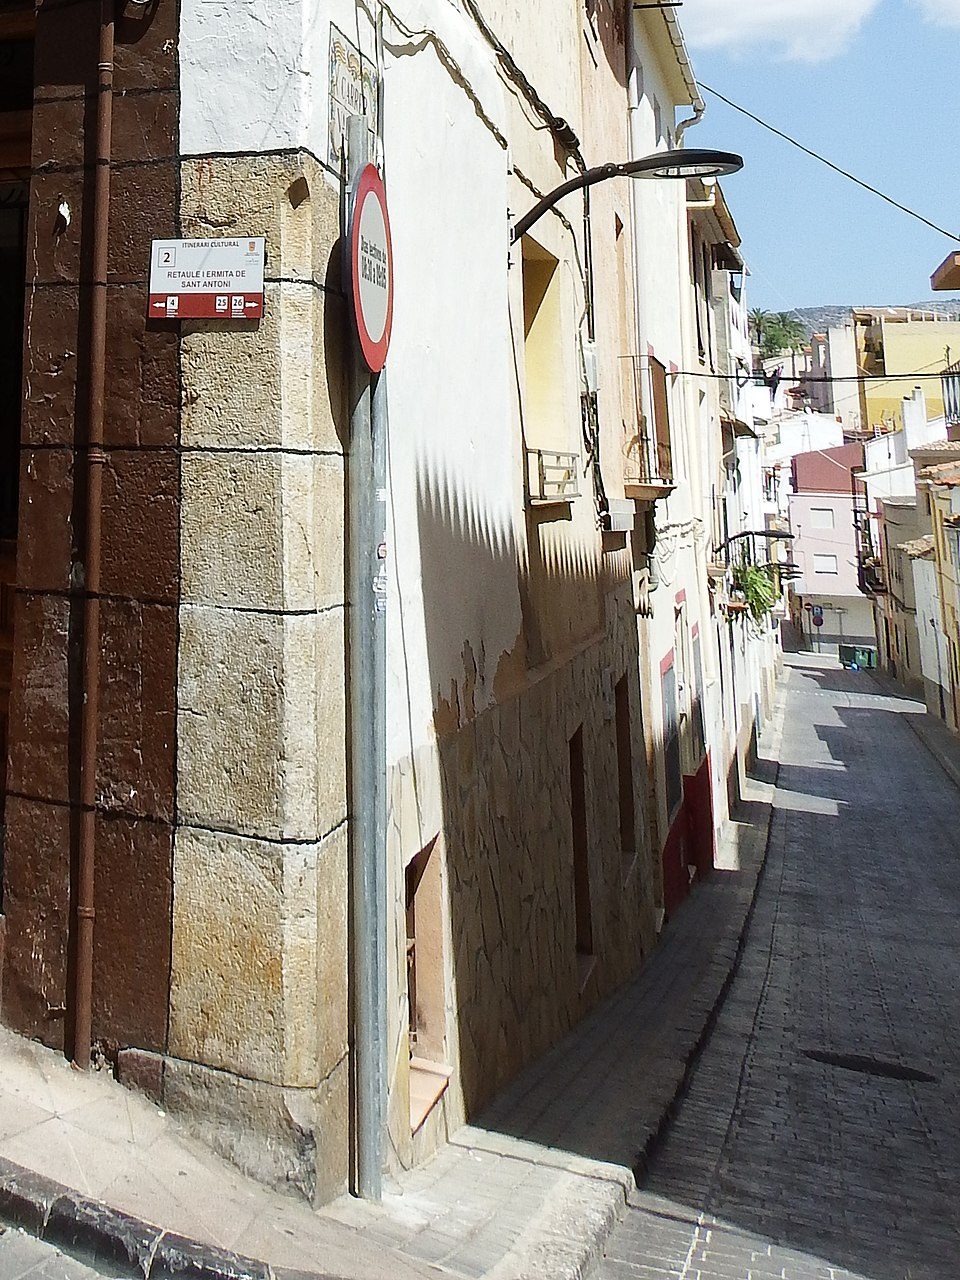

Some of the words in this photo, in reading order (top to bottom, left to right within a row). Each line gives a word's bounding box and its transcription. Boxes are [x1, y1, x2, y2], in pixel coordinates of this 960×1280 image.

[163, 252, 171, 263] 2
[167, 271, 200, 279] RETAULE
[206, 270, 234, 278] ERMITA
[235, 270, 246, 278] DE
[202, 280, 231, 288] ANTONI
[170, 299, 176, 307] 4
[217, 298, 227, 307] 25
[233, 298, 243, 307] 26
